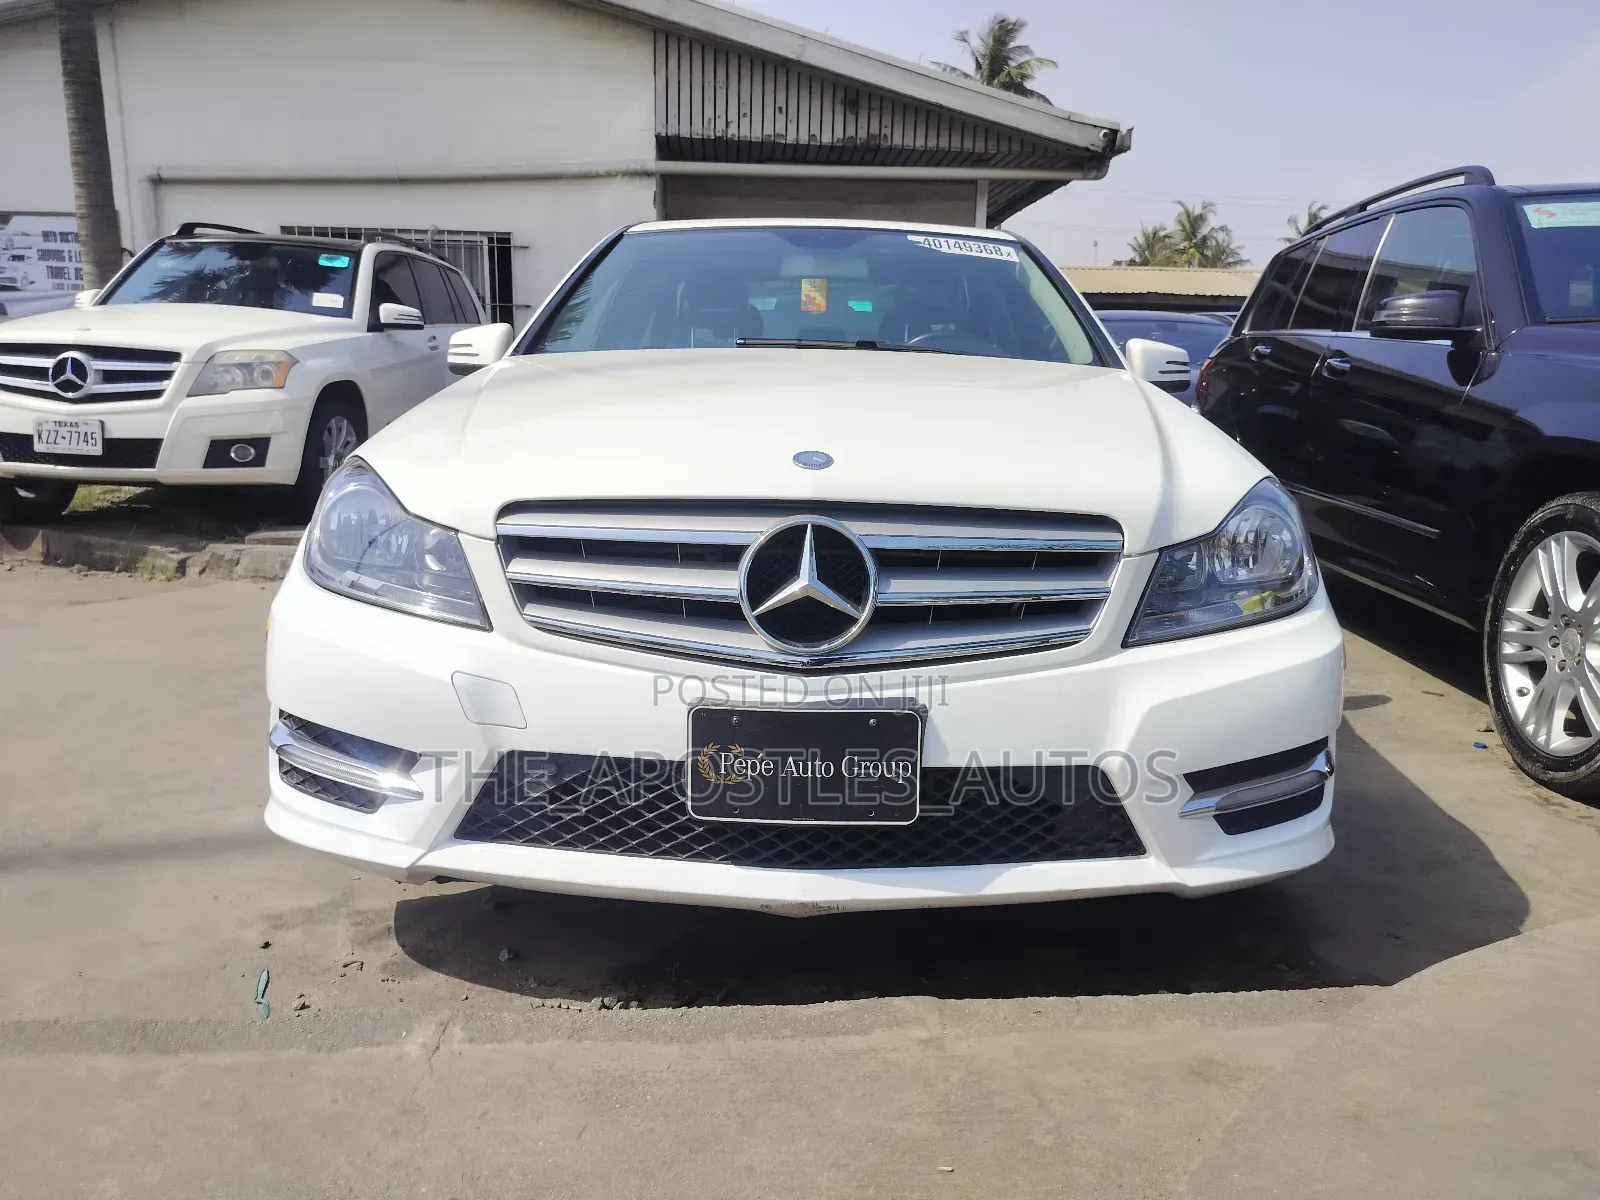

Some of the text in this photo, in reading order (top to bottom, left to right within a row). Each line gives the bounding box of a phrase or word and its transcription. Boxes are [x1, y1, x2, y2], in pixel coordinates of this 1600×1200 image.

[46, 265, 72, 280] TRAVEL
[53, 420, 80, 428] TEXAS
[780, 754, 834, 778] Auto
[841, 755, 912, 784] Group
